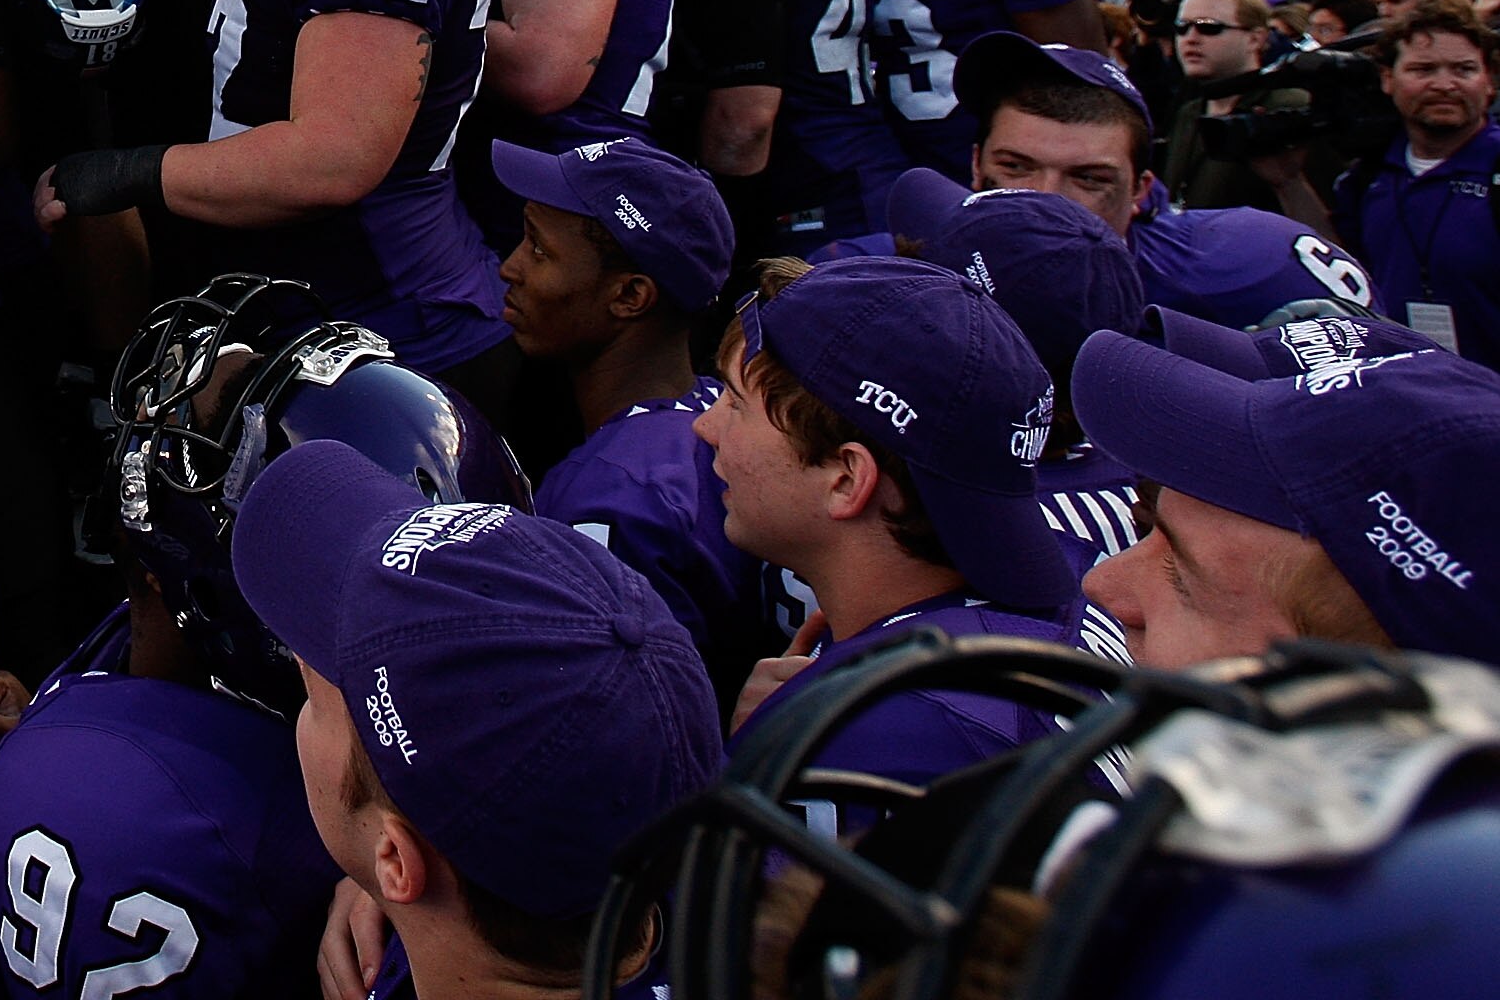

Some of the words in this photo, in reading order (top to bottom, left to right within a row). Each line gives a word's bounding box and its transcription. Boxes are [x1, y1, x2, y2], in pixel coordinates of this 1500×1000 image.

[616, 194, 652, 232] FOOTBALL
[1450, 180, 1488, 198] TCU
[614, 208, 636, 229] 2009
[972, 251, 996, 295] FOOTBALL
[856, 380, 918, 428] TCU
[1365, 526, 1426, 581] 2009
[1368, 491, 1474, 590] FOOTBALL
[366, 696, 392, 747] 2009
[374, 666, 420, 764] FOOTBALL
[0, 829, 199, 1000] 92
